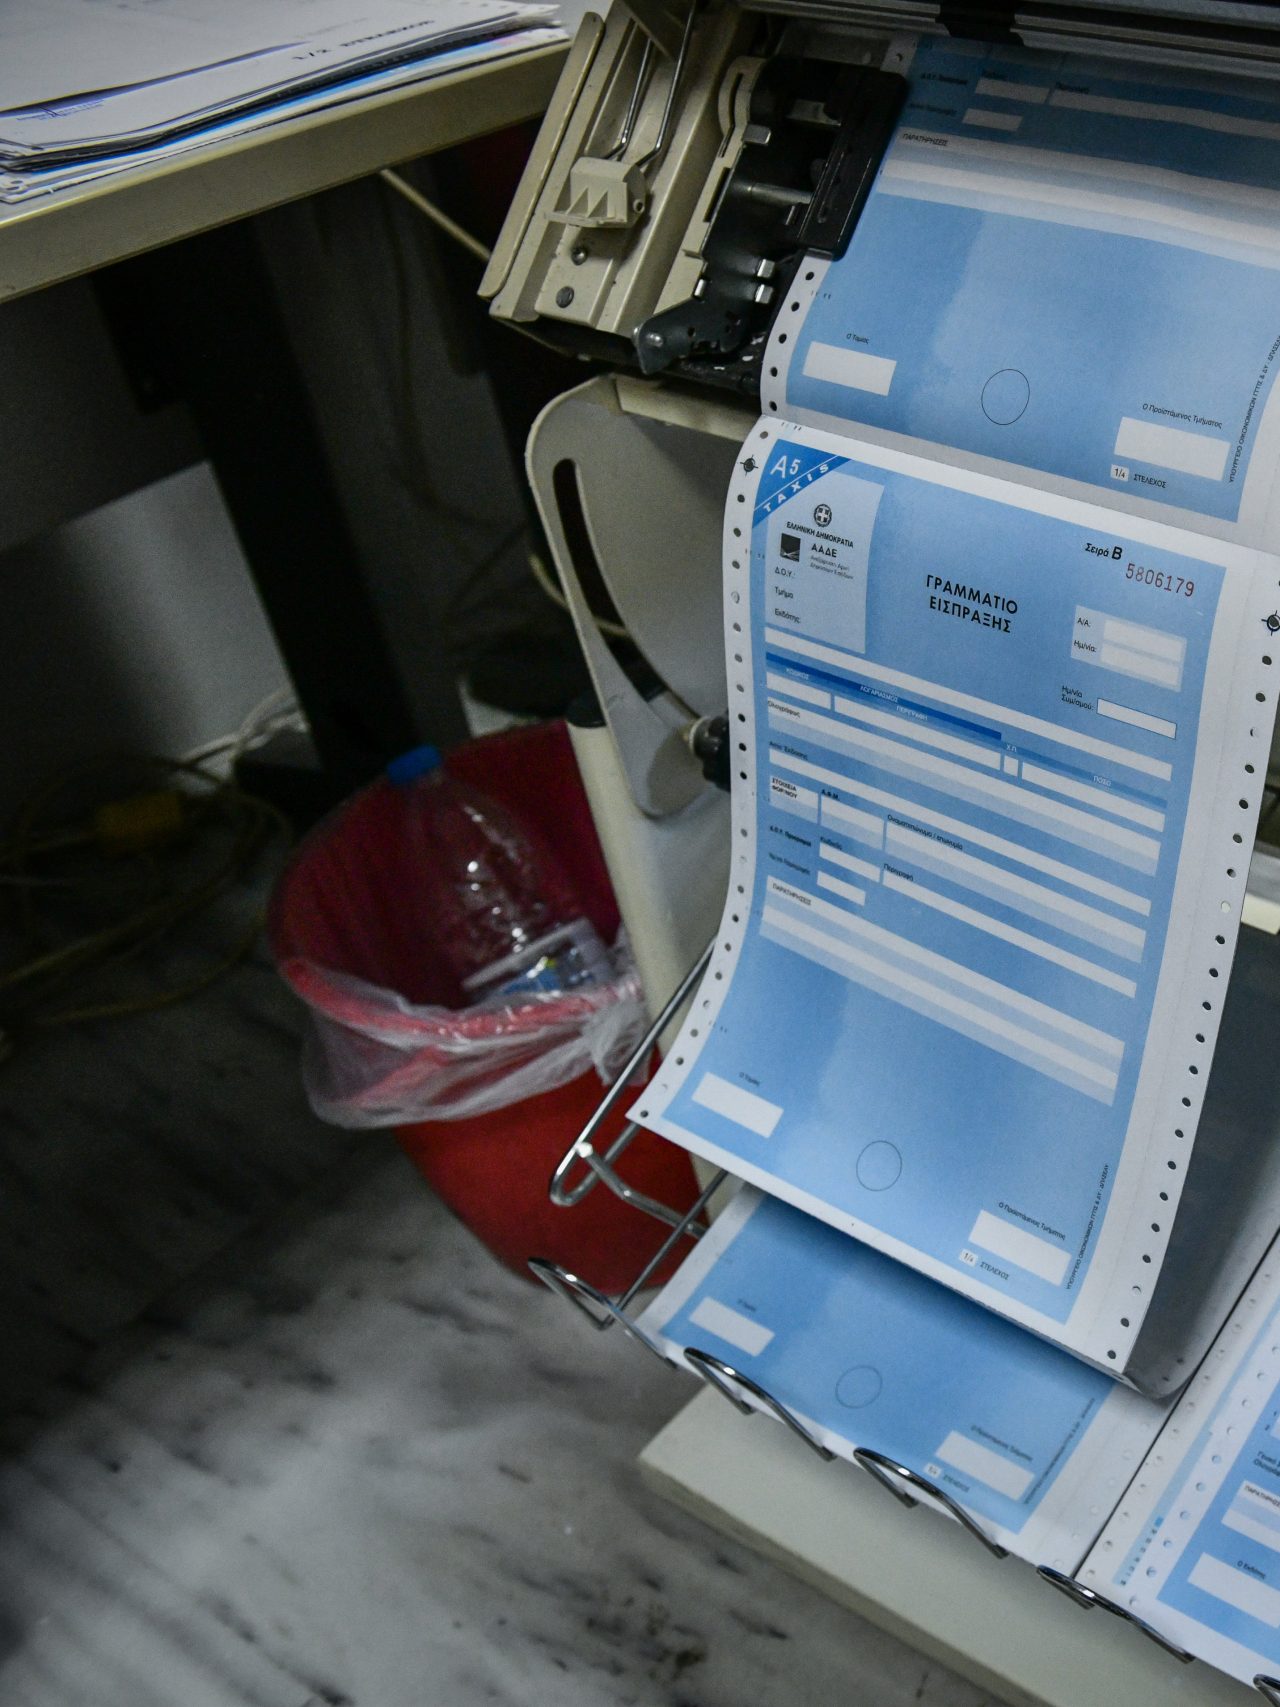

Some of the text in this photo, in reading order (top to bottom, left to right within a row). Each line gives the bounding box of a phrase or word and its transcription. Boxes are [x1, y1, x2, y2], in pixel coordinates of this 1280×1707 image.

[770, 455, 801, 479] A5
[1134, 473, 1167, 488] ΣΤΕΛΕΧΟΣ
[763, 463, 829, 512] TAXIS
[787, 521, 854, 548] ΕΛΛΗΝΙΚΗ ΔΗΜΟΚΡΑΤΙΑ
[811, 543, 838, 557] ΑΑΔΕ
[1085, 543, 1123, 560] Σειρά Β
[1126, 562, 1195, 597] 5806179
[926, 574, 1018, 614] ΓΡΑΜΜΑΤΙΟ
[929, 596, 1011, 633] ΕΙΣΠΡΑΞΗΣ
